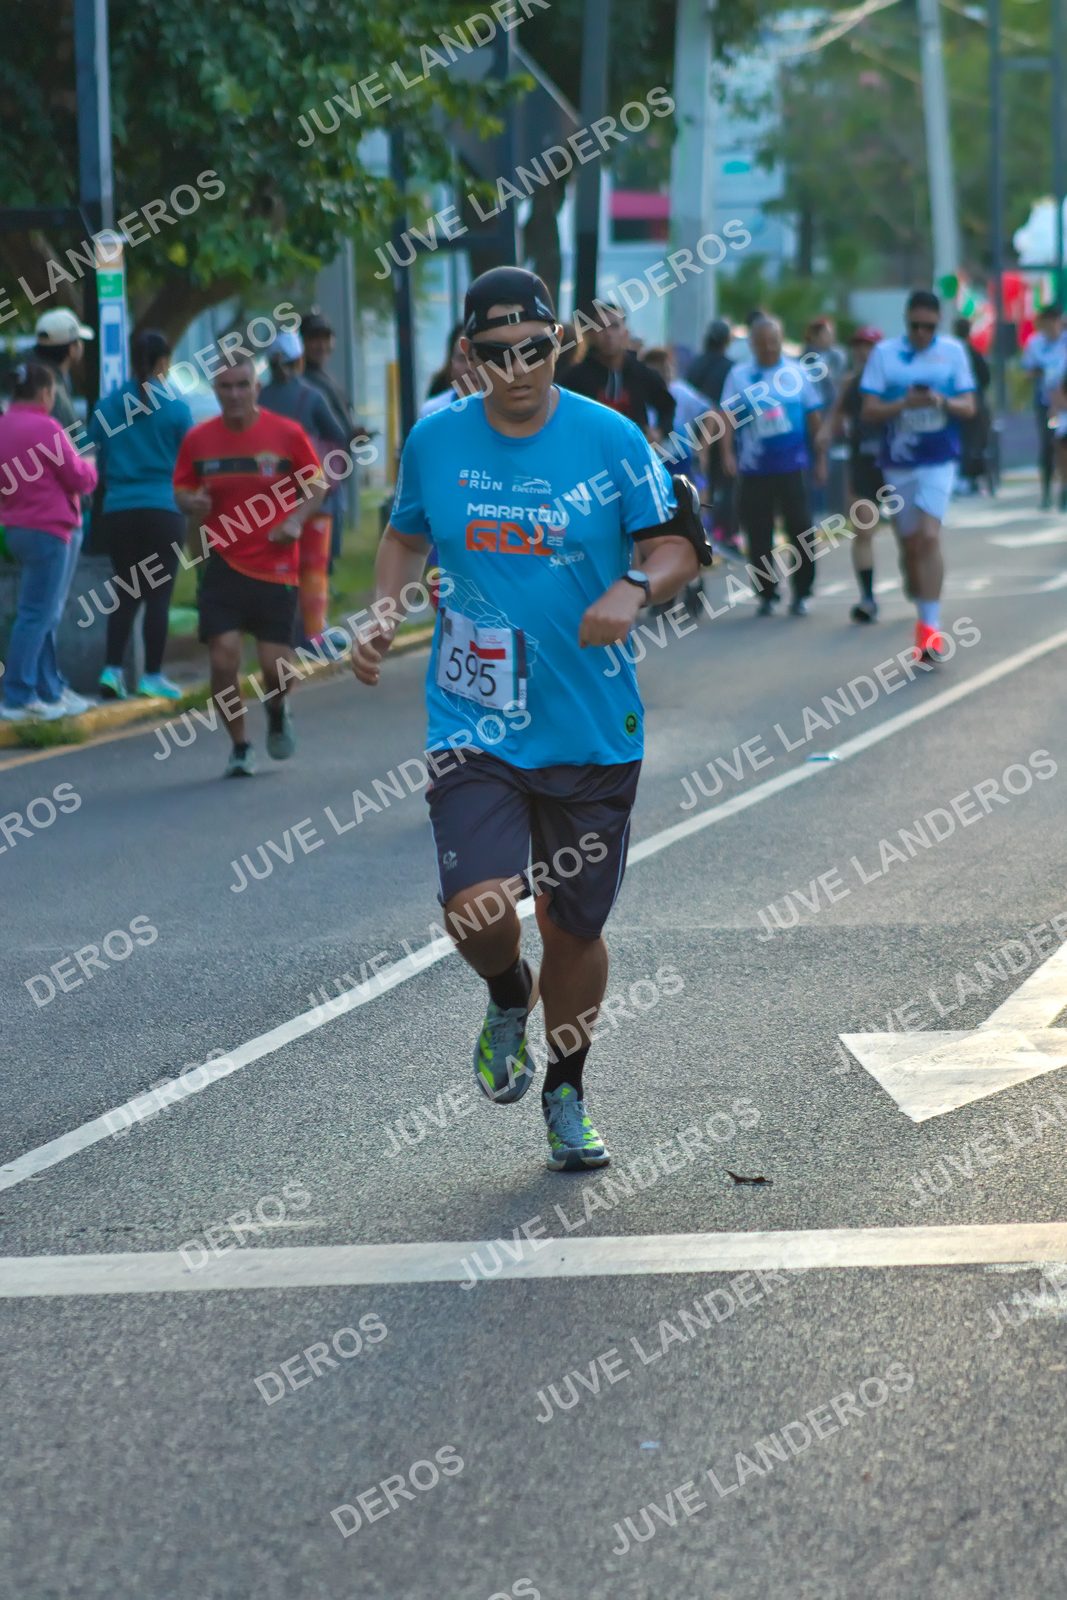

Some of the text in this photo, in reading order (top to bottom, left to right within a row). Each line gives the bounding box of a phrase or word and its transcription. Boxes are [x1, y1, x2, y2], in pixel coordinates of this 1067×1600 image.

[459, 469, 492, 480] GDL
[469, 479, 503, 491] RUN
[465, 519, 553, 556] GDL
[547, 536, 564, 547] 25
[446, 647, 496, 697] 595
